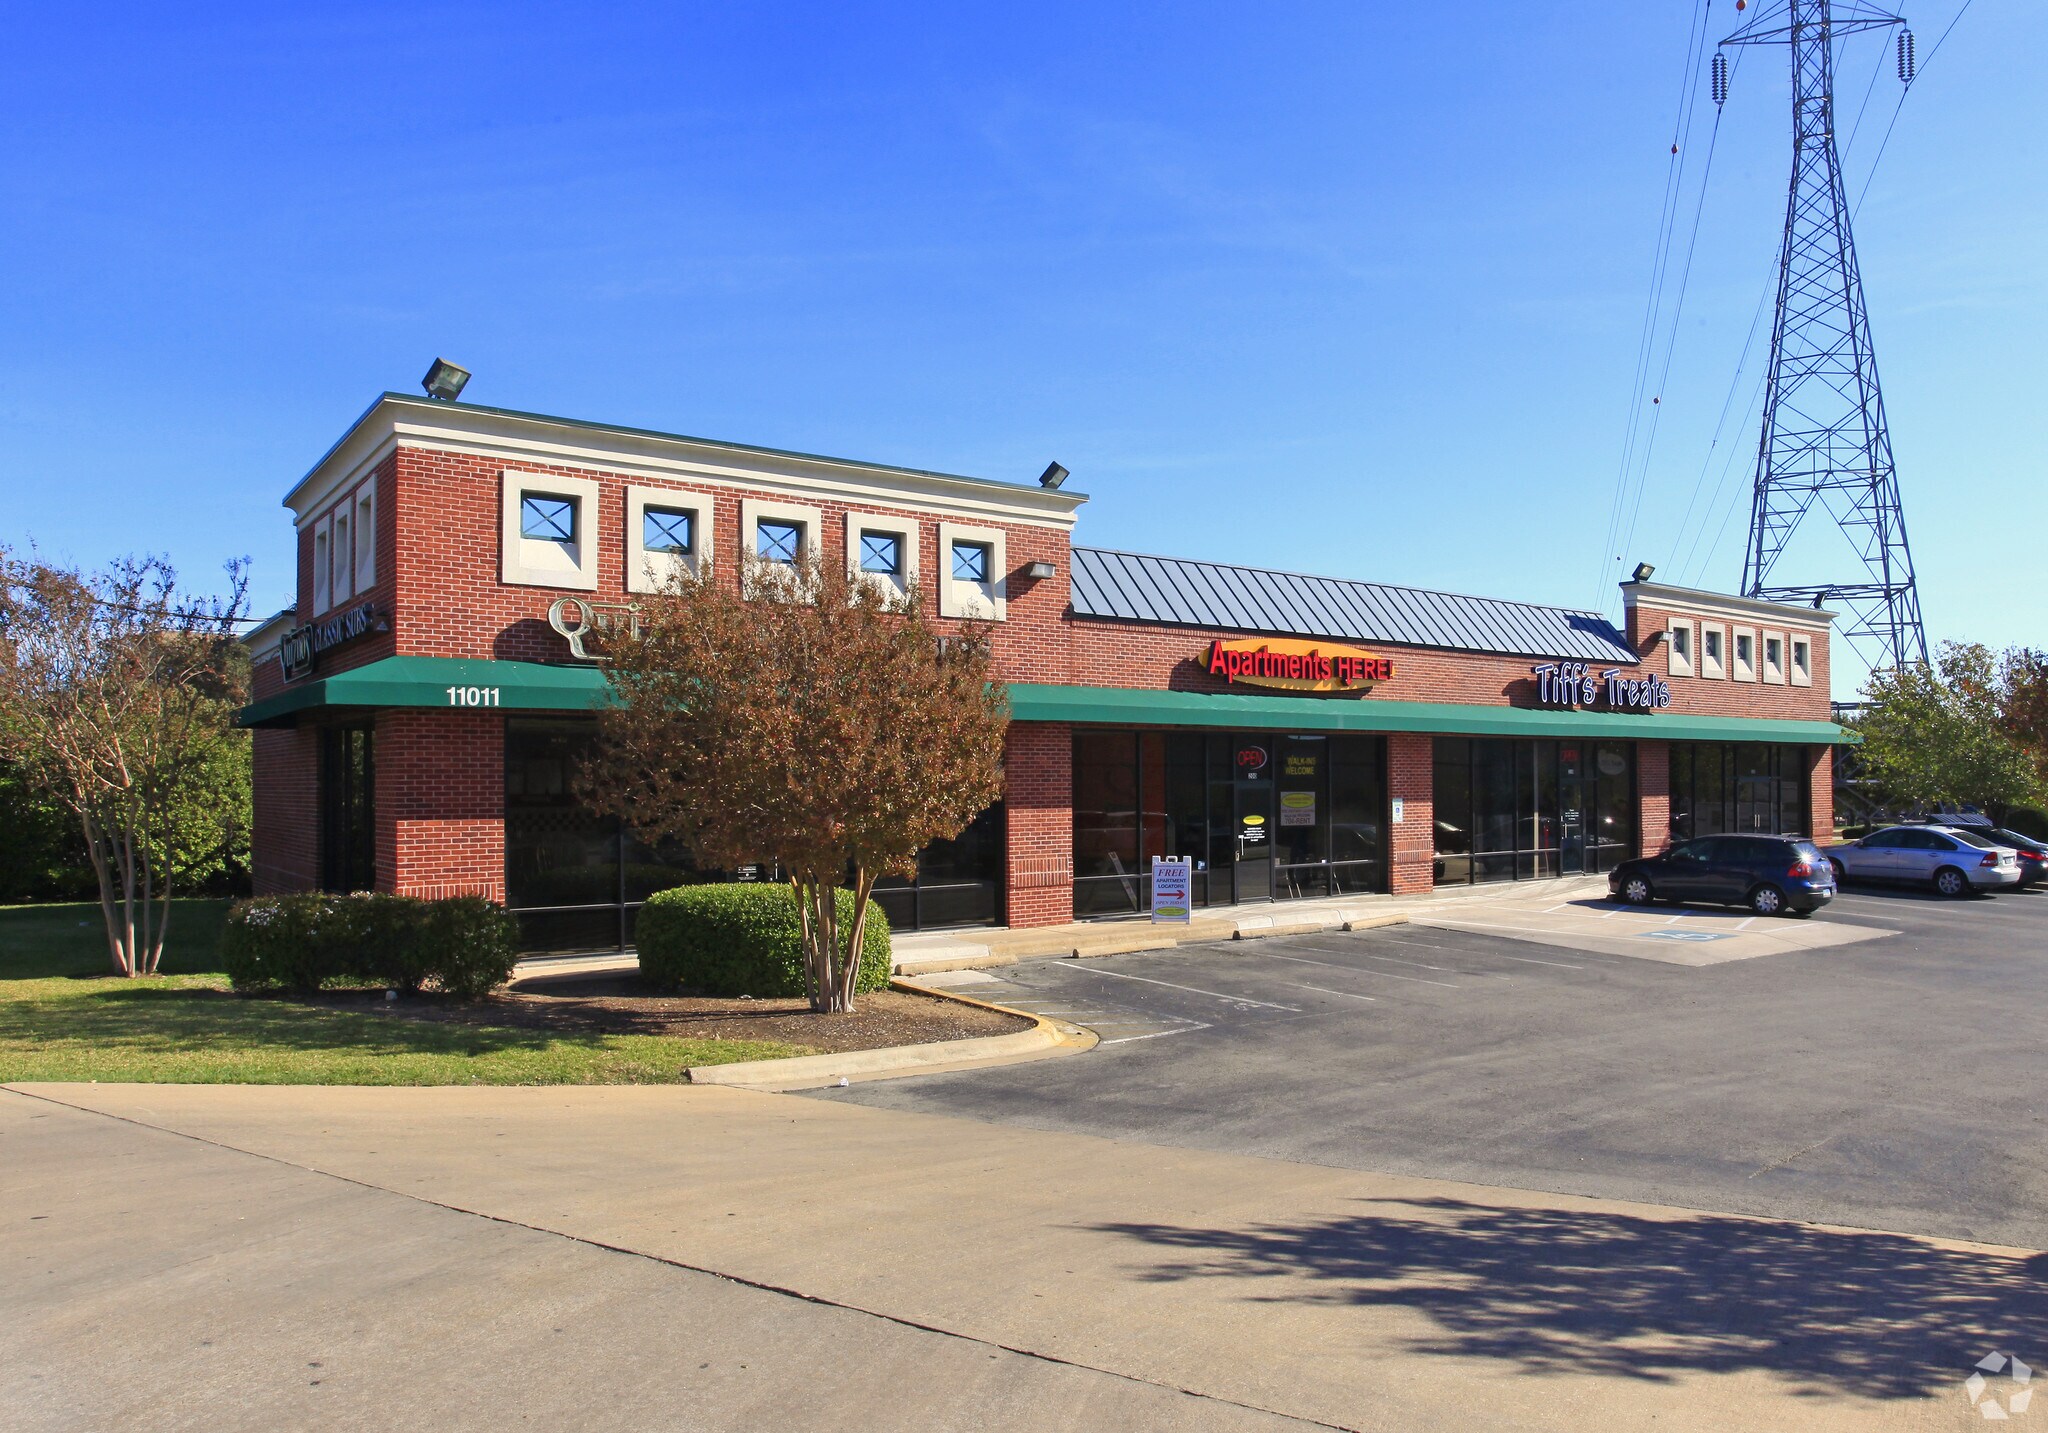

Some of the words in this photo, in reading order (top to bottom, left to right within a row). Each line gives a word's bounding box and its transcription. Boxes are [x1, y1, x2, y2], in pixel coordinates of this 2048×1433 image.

[315, 616, 344, 652] CLASSIC
[346, 607, 367, 638] SUBS
[1209, 640, 1332, 684] Apartments
[1338, 656, 1394, 686] HERE!
[446, 686, 500, 706] 11011
[1535, 661, 1596, 705] Tiff's
[1603, 668, 1671, 708] Treats
[1237, 751, 1263, 766] OPEN
[1285, 766, 1314, 775] WELCOME
